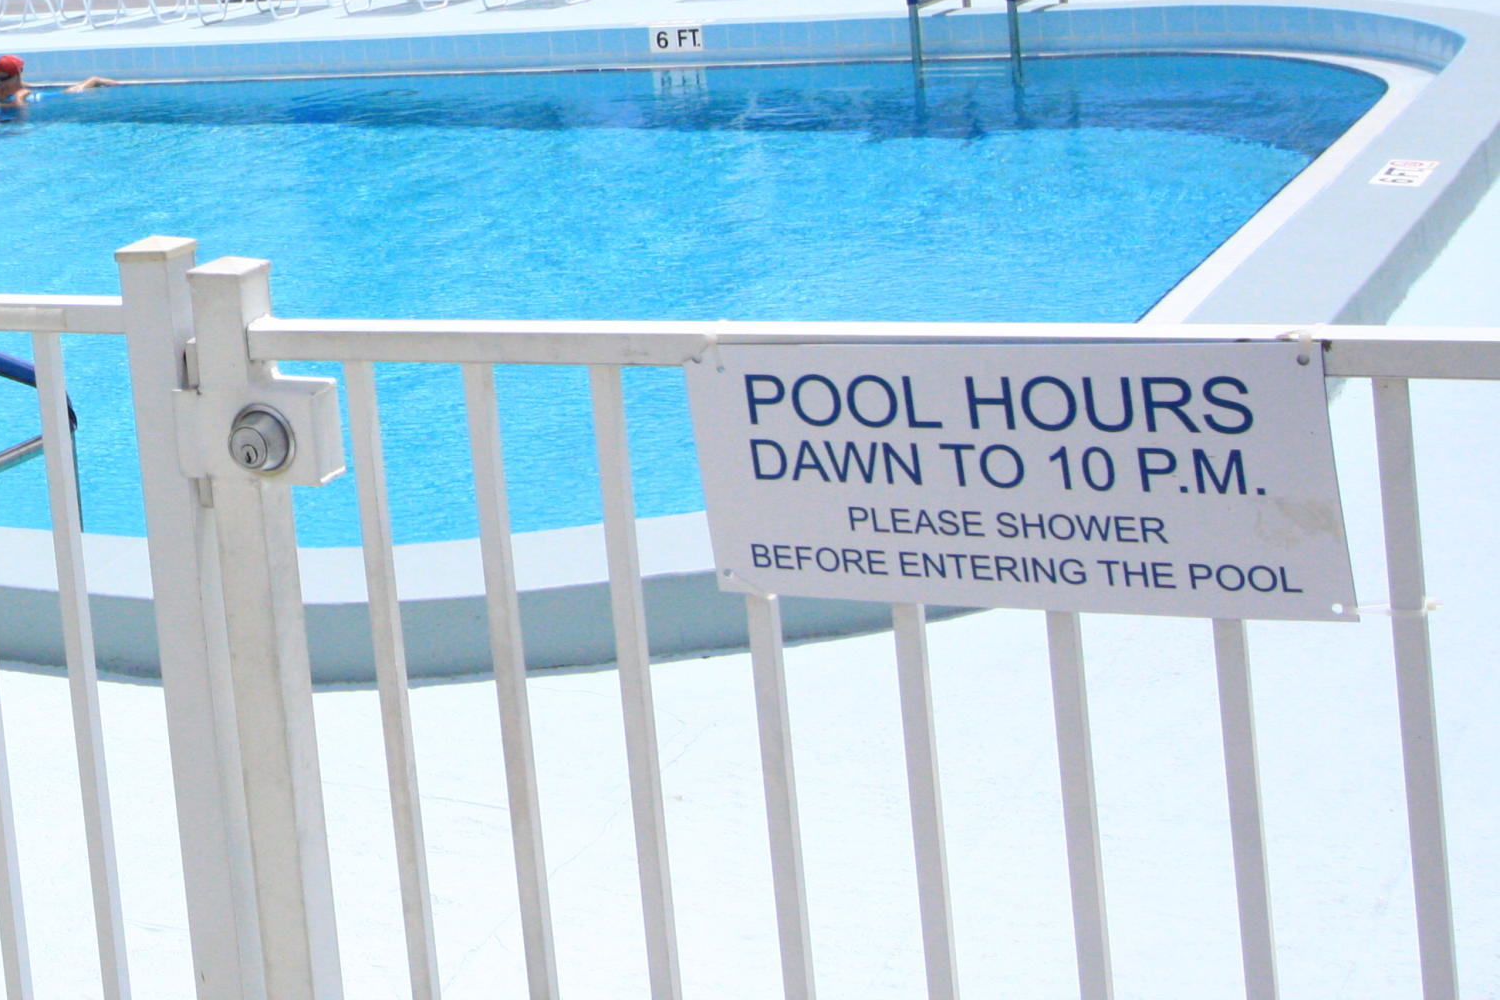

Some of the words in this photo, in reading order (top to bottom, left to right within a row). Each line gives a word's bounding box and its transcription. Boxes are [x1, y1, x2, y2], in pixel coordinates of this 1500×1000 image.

[656, 31, 669, 49] 6
[677, 28, 701, 47] FT.
[744, 373, 943, 429] POOL
[965, 375, 1254, 435] HOURS
[750, 438, 922, 486] DAWN
[939, 443, 1025, 489] TO
[1049, 446, 1115, 492] 10
[1136, 447, 1267, 496] P.M.
[848, 506, 985, 538] PLEASE
[996, 512, 1168, 545] SHOWER
[750, 543, 889, 576] BEFORE
[899, 551, 1088, 586] ENTERING
[1097, 559, 1177, 590] THE
[1188, 563, 1303, 594] POOL
